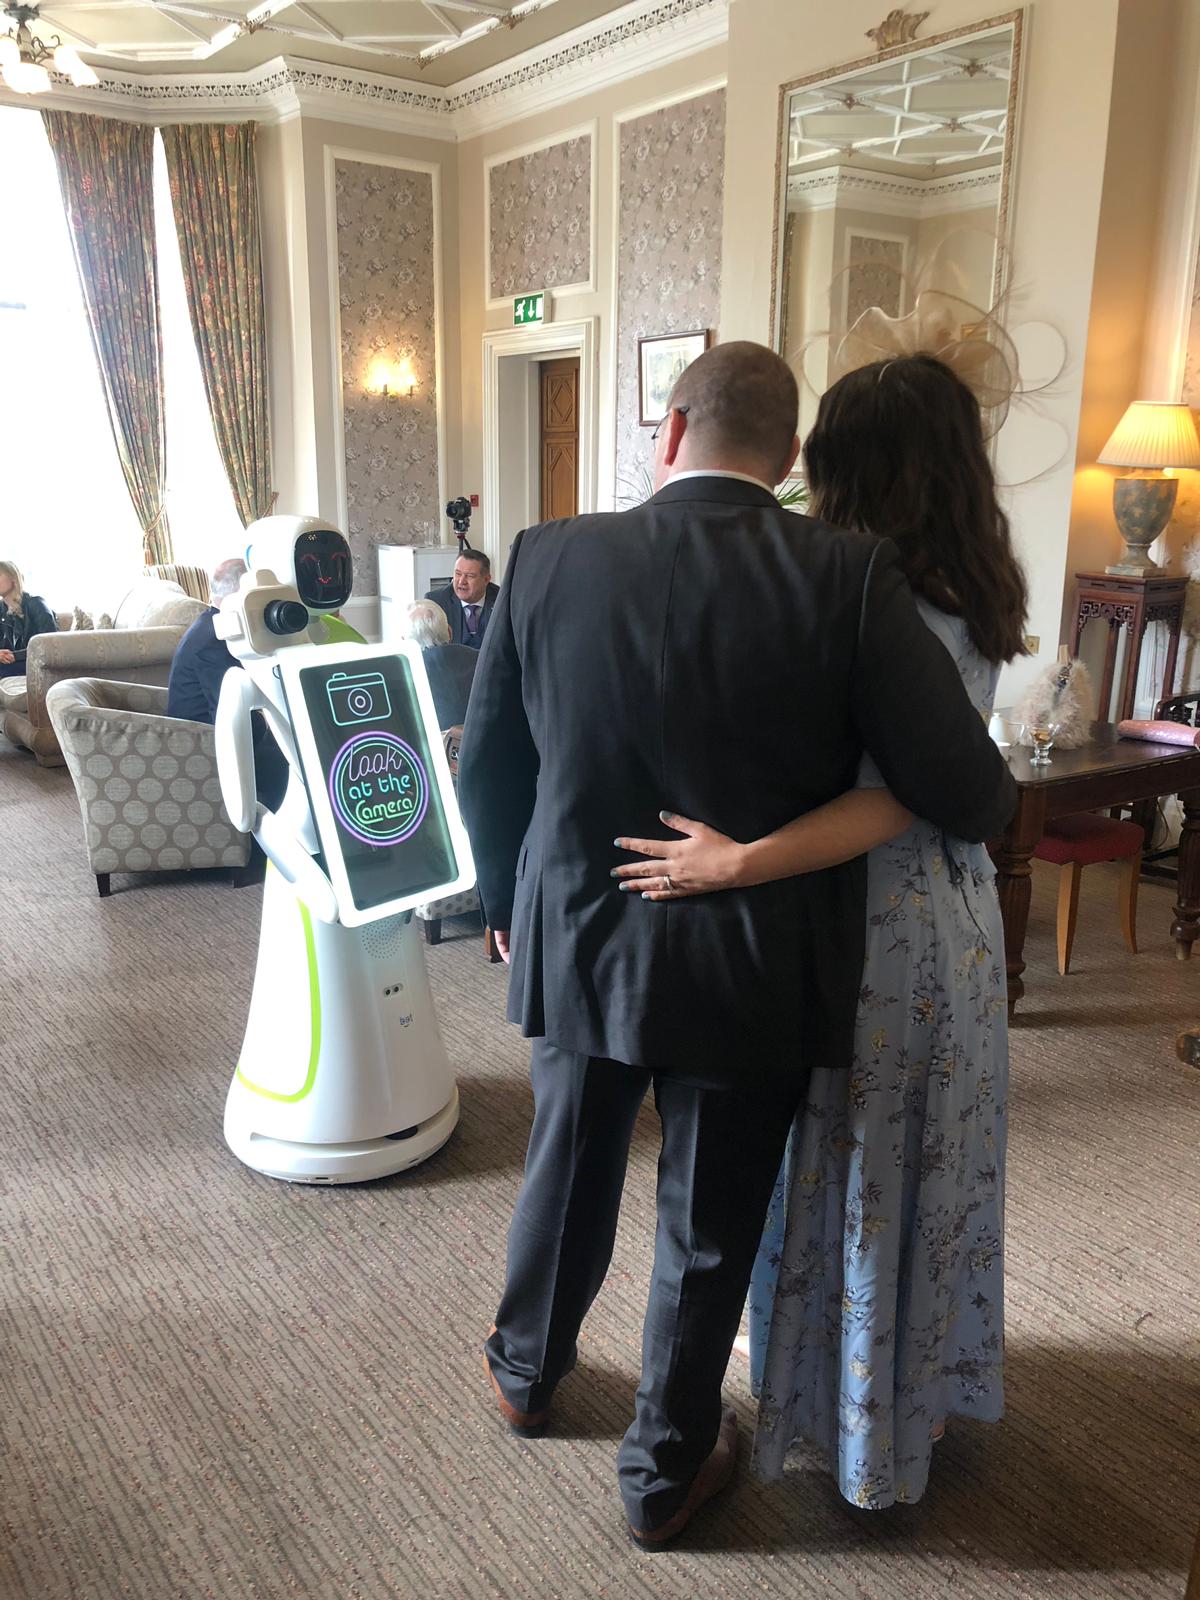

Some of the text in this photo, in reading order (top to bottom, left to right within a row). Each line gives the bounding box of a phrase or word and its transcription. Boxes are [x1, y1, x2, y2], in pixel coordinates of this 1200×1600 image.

[349, 773, 411, 799] at the
[355, 798, 414, 824] Camera
